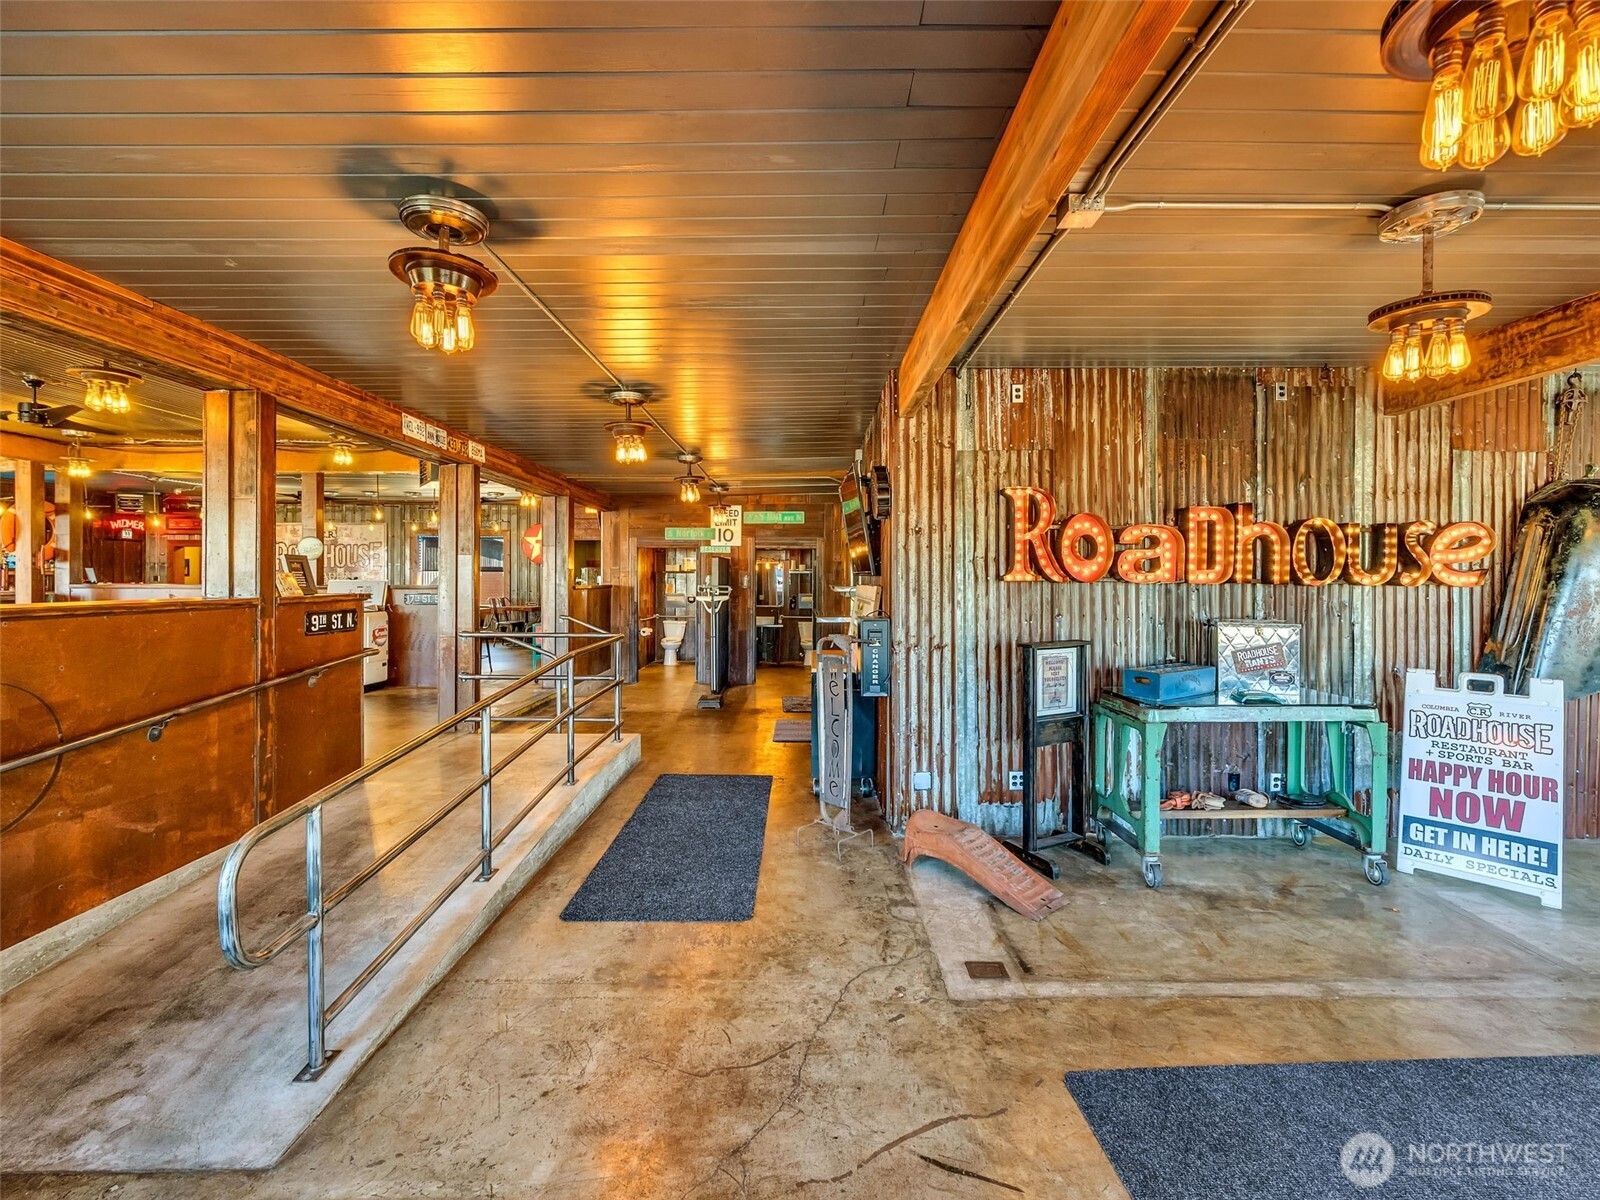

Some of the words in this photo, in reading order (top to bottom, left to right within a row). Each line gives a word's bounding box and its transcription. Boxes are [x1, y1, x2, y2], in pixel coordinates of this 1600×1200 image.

[110, 519, 145, 531] WIDMER
[676, 528, 705, 538] Norfolk
[718, 528, 734, 542] 10
[311, 614, 327, 632] 9TH
[331, 613, 344, 630] ST.
[347, 613, 355, 628] N.
[1237, 644, 1279, 662] ROADHOUSE
[1421, 703, 1460, 713] COLUMBIA
[1499, 711, 1531, 720] RIVER
[1409, 709, 1554, 755] ROADHOUSE
[1431, 740, 1529, 761] RESTAURANT
[1438, 750, 1493, 765] SPORTS
[1502, 759, 1535, 772] BAR
[1408, 757, 1484, 789] HAPPY
[1488, 769, 1559, 803] HOUR
[1428, 786, 1527, 833] NOW
[1409, 822, 1449, 847] GET
[1452, 830, 1476, 853] IN
[1481, 836, 1549, 868] HERE!
[1403, 846, 1454, 865] DAILY
[1465, 859, 1557, 889] SPECIALS
